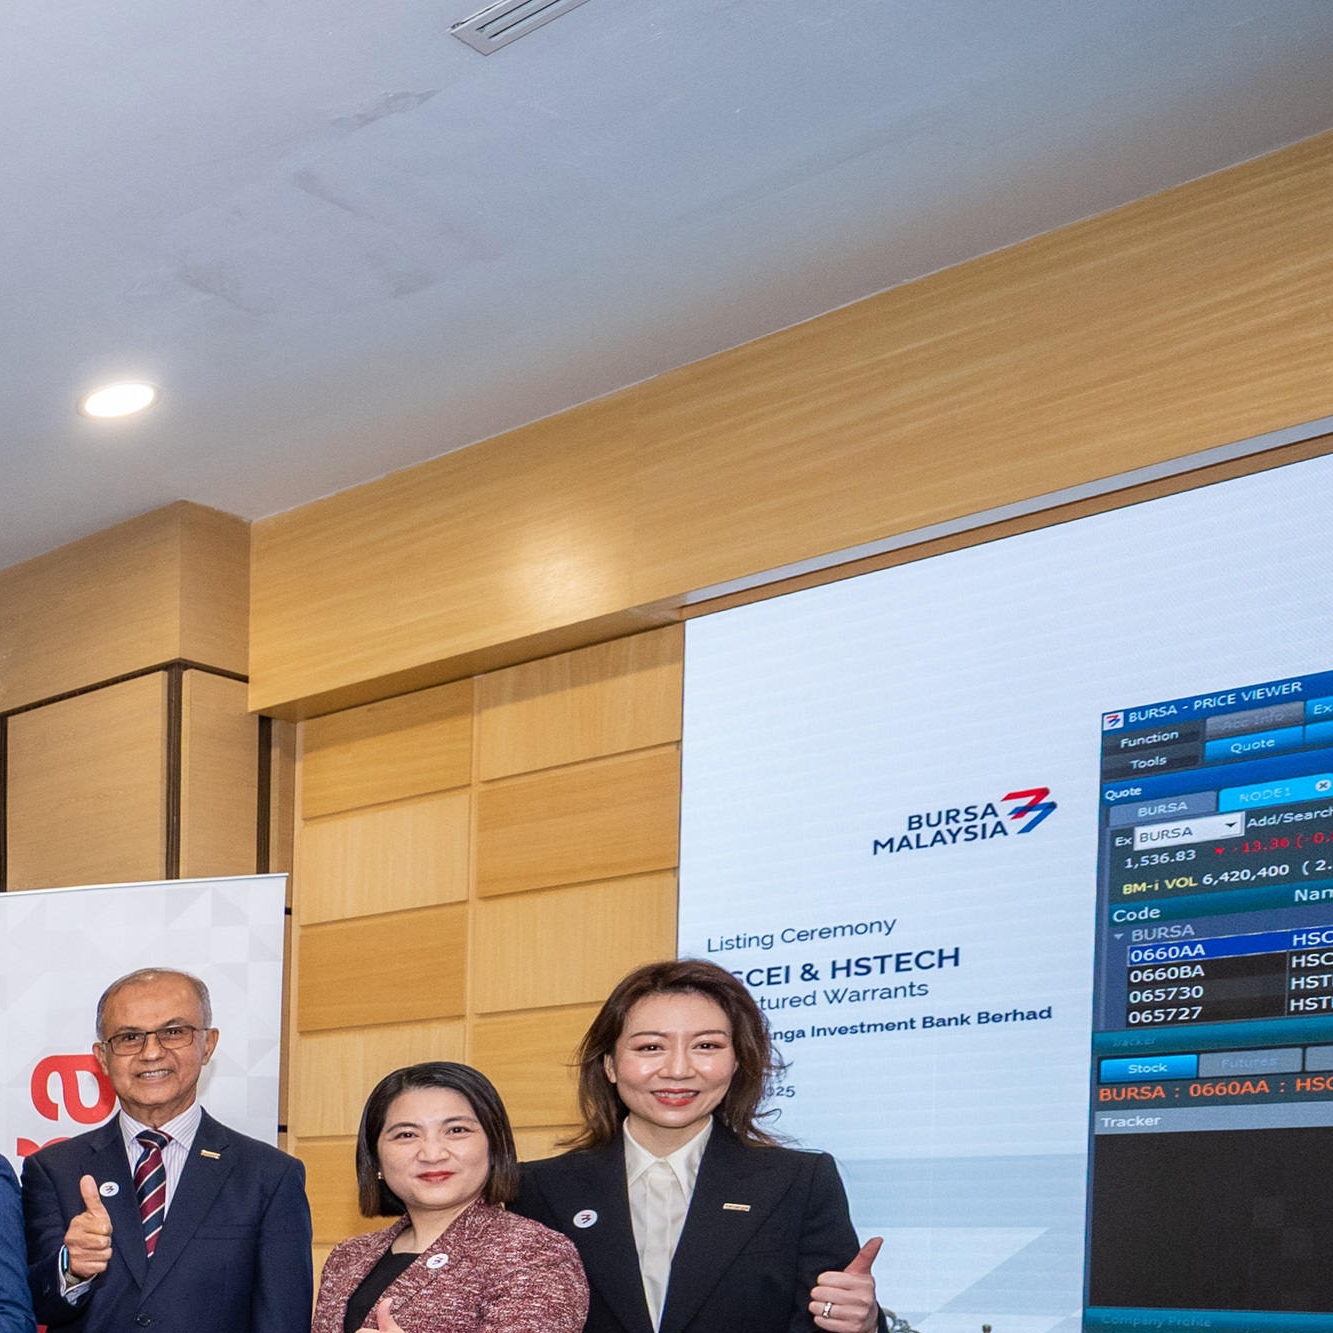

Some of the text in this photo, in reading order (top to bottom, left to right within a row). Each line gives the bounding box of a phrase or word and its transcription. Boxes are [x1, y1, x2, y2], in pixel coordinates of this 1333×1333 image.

[1129, 704, 1178, 723] BURSA
[1194, 693, 1236, 710] PRICE
[1241, 681, 1302, 702] VIEWER
[1120, 730, 1179, 748] Function
[1230, 738, 1276, 754] Quote
[1130, 756, 1167, 770] Tools
[1105, 786, 1142, 801] Quote
[907, 802, 999, 832] BURSA
[1138, 801, 1189, 818] BURSA
[873, 820, 1008, 856] MALAYSIA
[1115, 836, 1132, 847] Ex
[1139, 827, 1193, 844] BURSA
[1124, 850, 1197, 870] 1,536.83
[1122, 878, 1160, 896] BM-i
[1165, 875, 1199, 890] VOL
[1202, 864, 1290, 886] 6,420,400
[1112, 906, 1161, 923] Code
[707, 918, 897, 953] Listing Ceremony
[1132, 924, 1196, 942] BURSA
[1130, 944, 1206, 963] 0660AA
[800, 962, 820, 982] &
[831, 947, 961, 980] HSTECH
[1129, 964, 1206, 983] 0660BA
[759, 981, 930, 1011] tured Warrants
[1128, 974, 1333, 1004] 065730 HST
[1128, 996, 1333, 1025] 065727 HST
[772, 1006, 1053, 1043] nga Investment Bank Berhad
[1128, 1062, 1168, 1075] Stock
[1099, 1085, 1166, 1102] BURSA
[1189, 1080, 1270, 1097] 0660AA
[1100, 1115, 1162, 1128] Tracker
